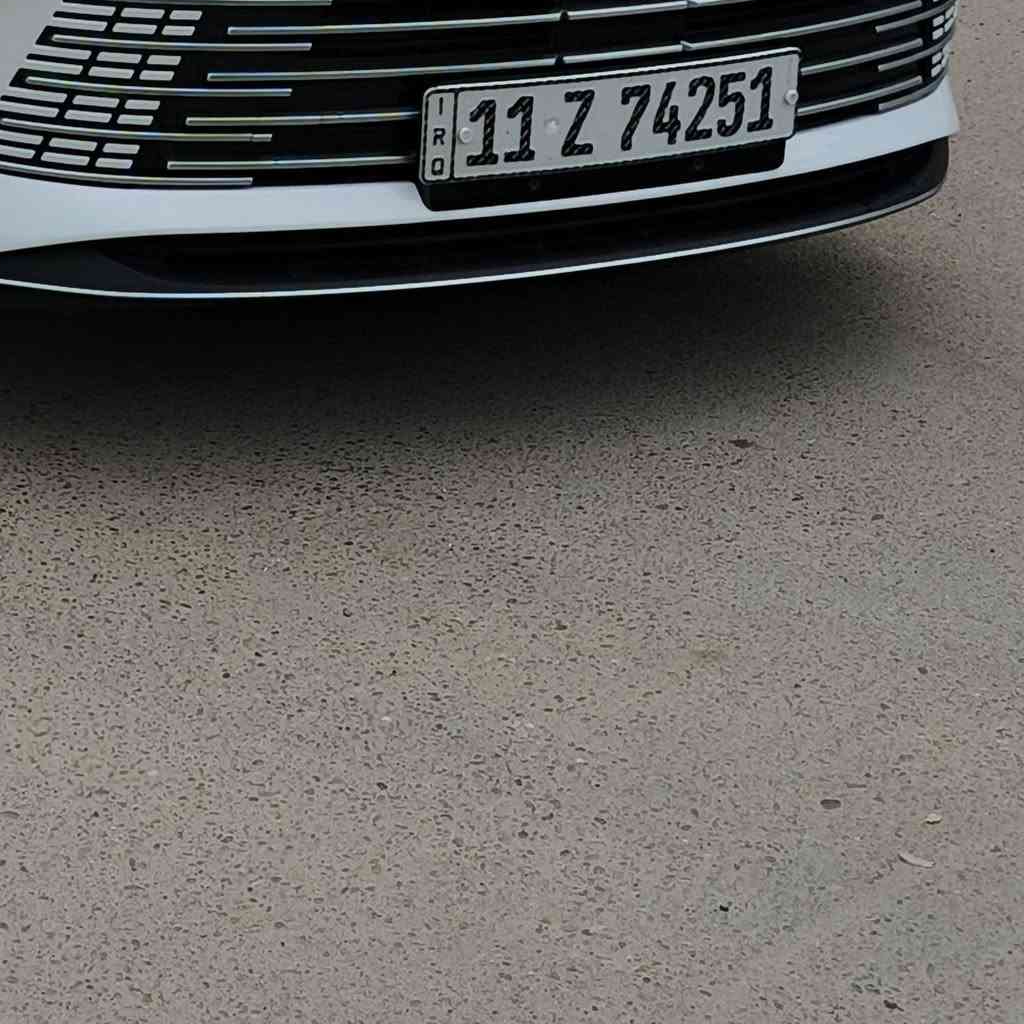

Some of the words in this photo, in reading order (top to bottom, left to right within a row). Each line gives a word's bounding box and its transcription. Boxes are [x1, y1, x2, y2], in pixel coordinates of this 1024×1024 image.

[466, 95, 536, 167] 11
[561, 89, 596, 158] Z
[619, 66, 774, 152] 74251
